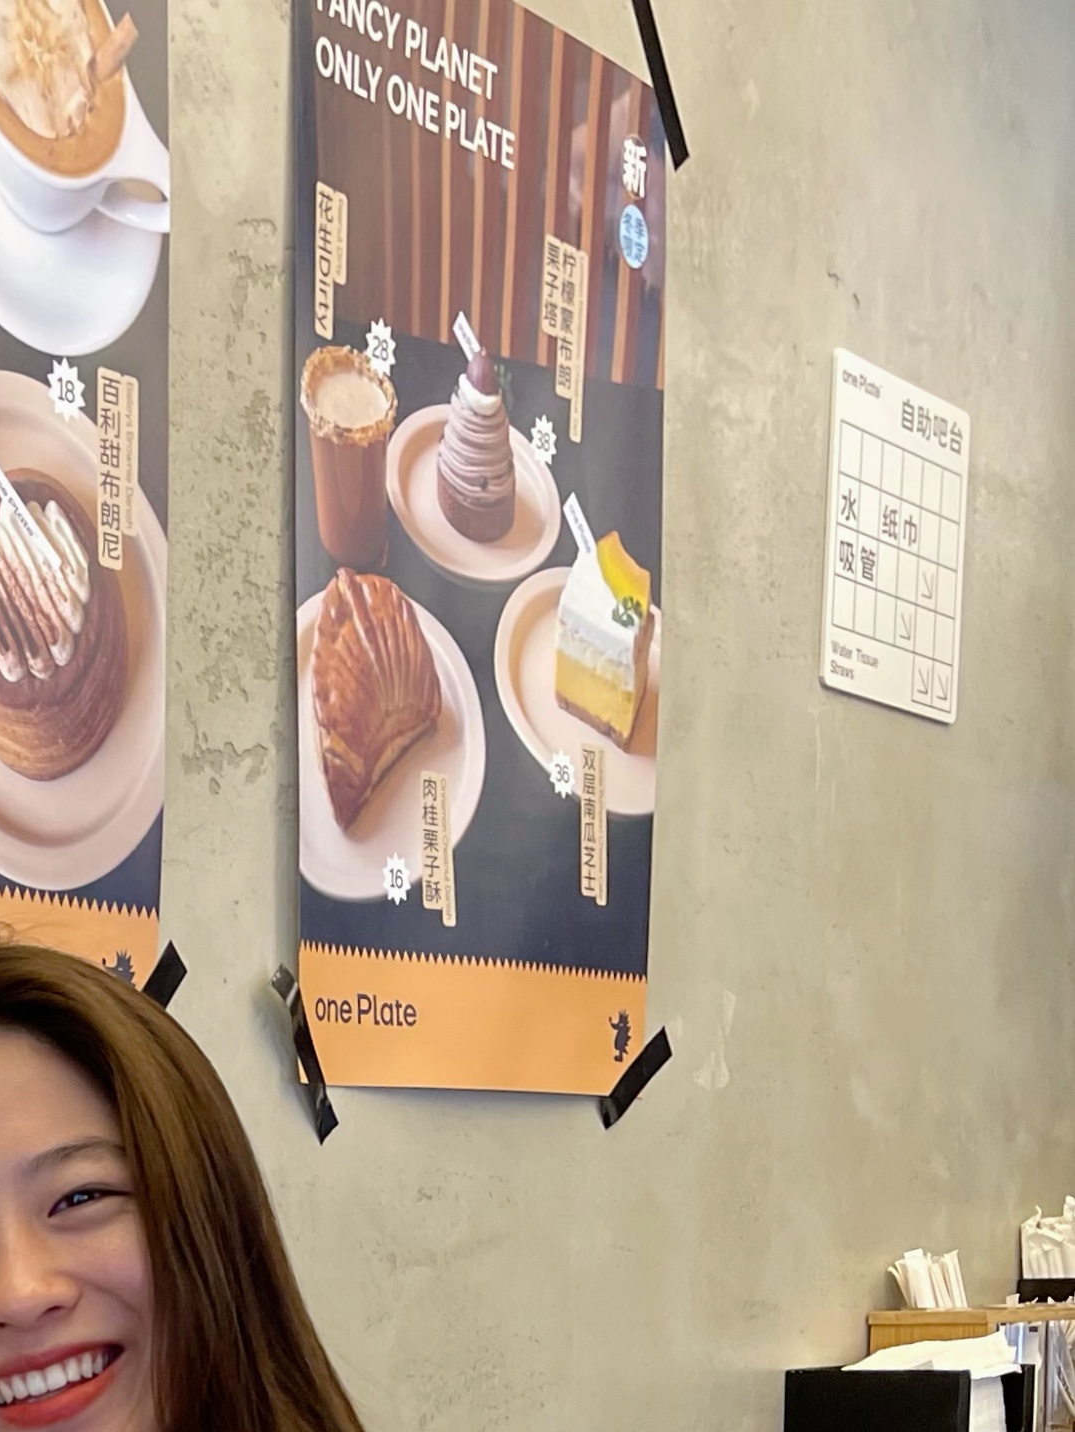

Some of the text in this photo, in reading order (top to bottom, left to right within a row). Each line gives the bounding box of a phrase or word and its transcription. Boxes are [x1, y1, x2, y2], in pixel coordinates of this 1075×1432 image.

[405, 18, 499, 100] PLANET
[315, 36, 516, 170] ONLY ONE PLATE
[622, 138, 647, 198] 新
[371, 335, 389, 361] 28
[57, 377, 75, 403] 18
[535, 429, 550, 452] 38
[901, 398, 963, 455] 自助吧台
[99, 375, 121, 561] 百利甜布朗尼
[841, 488, 917, 547] 水 纸巾
[839, 540, 875, 582] 吸管
[555, 764, 570, 783] 36
[422, 777, 442, 905] 肉桂栗子酥
[582, 749, 596, 892] 双层南瓜芝士
[389, 868, 403, 889] 16
[315, 993, 417, 1027] one Plate
